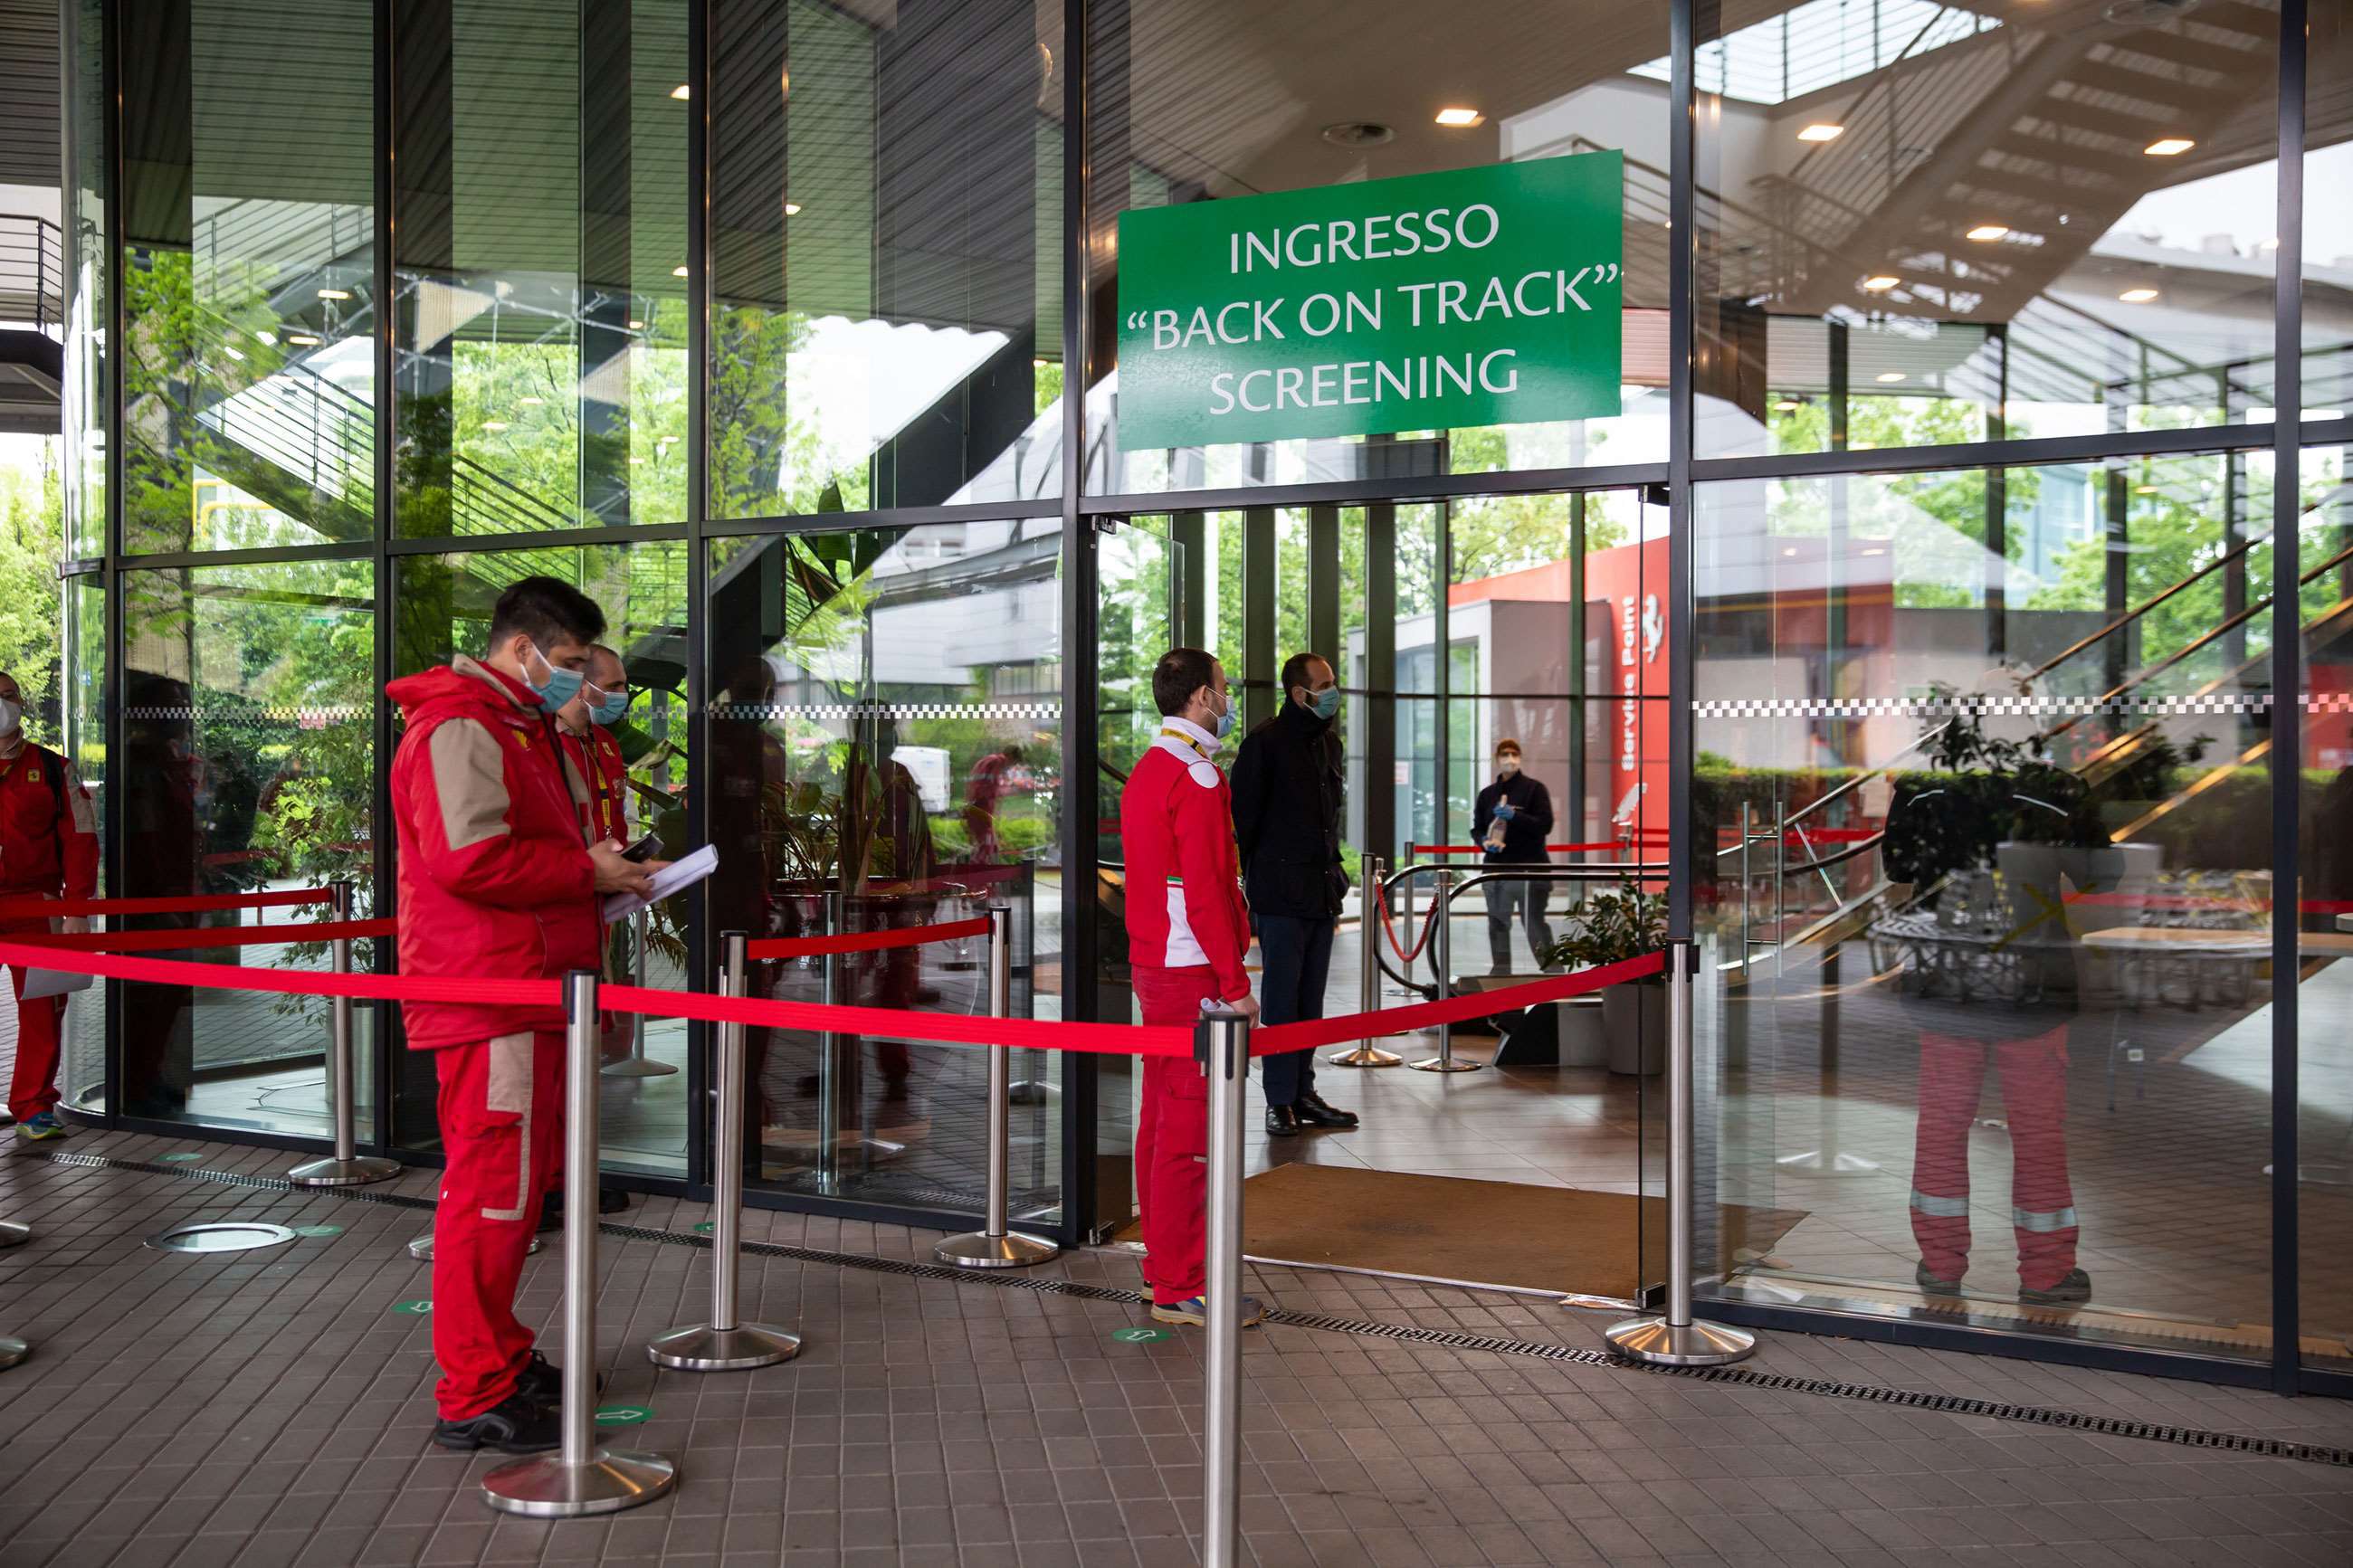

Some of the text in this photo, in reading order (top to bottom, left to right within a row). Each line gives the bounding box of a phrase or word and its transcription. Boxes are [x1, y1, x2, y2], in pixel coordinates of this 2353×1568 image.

[1230, 204, 1500, 274] INGRESSO
[1128, 263, 1619, 350] “BACK ON TRACK”
[1209, 348, 1518, 415] SCREENING
[1621, 595, 1635, 771] Service Point
